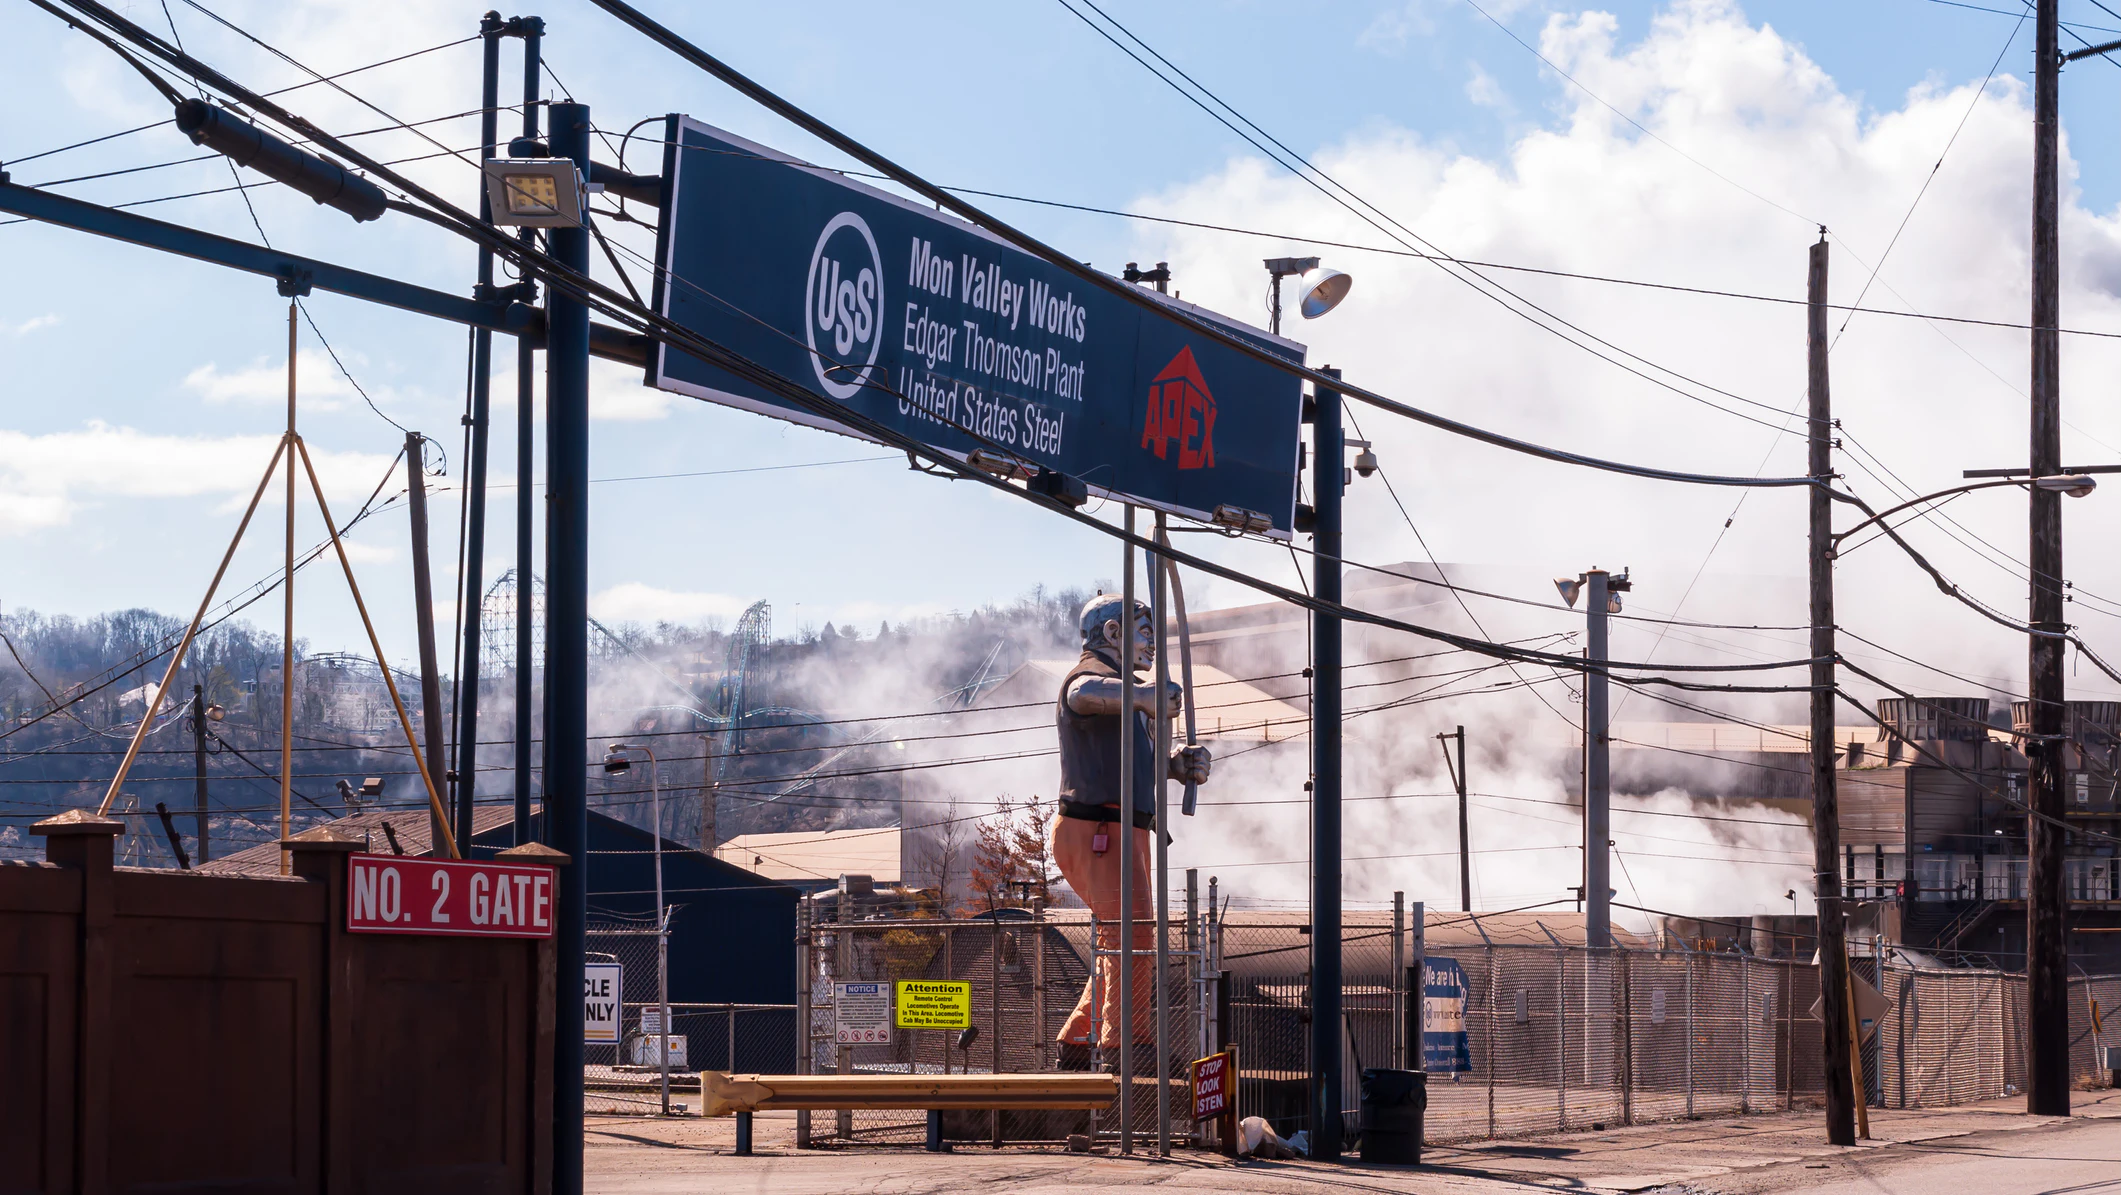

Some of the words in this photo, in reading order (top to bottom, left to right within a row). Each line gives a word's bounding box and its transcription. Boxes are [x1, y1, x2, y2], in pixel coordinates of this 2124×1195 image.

[908, 236, 954, 299] Mon
[961, 253, 1024, 331] Valley
[1029, 278, 1086, 343] Works
[818, 256, 875, 356] USS
[903, 301, 957, 370] Edgar
[963, 320, 1042, 391] Thomson
[1044, 347, 1085, 402] Plant
[898, 366, 959, 428] United
[962, 386, 1018, 445] States
[1022, 403, 1064, 456] Steel
[1141, 380, 1217, 470] APEX
[354, 866, 411, 923] NO.
[431, 869, 450, 923] 2
[469, 871, 549, 927] GATE
[1436, 970, 1448, 986] are
[848, 985, 876, 993] NOTICE
[905, 983, 963, 993] Attention
[585, 1003, 615, 1021] NLY
[914, 1017, 925, 1025] May
[1200, 1059, 1223, 1078] STOP
[1196, 1077, 1220, 1096] LOOK
[1197, 1093, 1223, 1113] ISTEN
